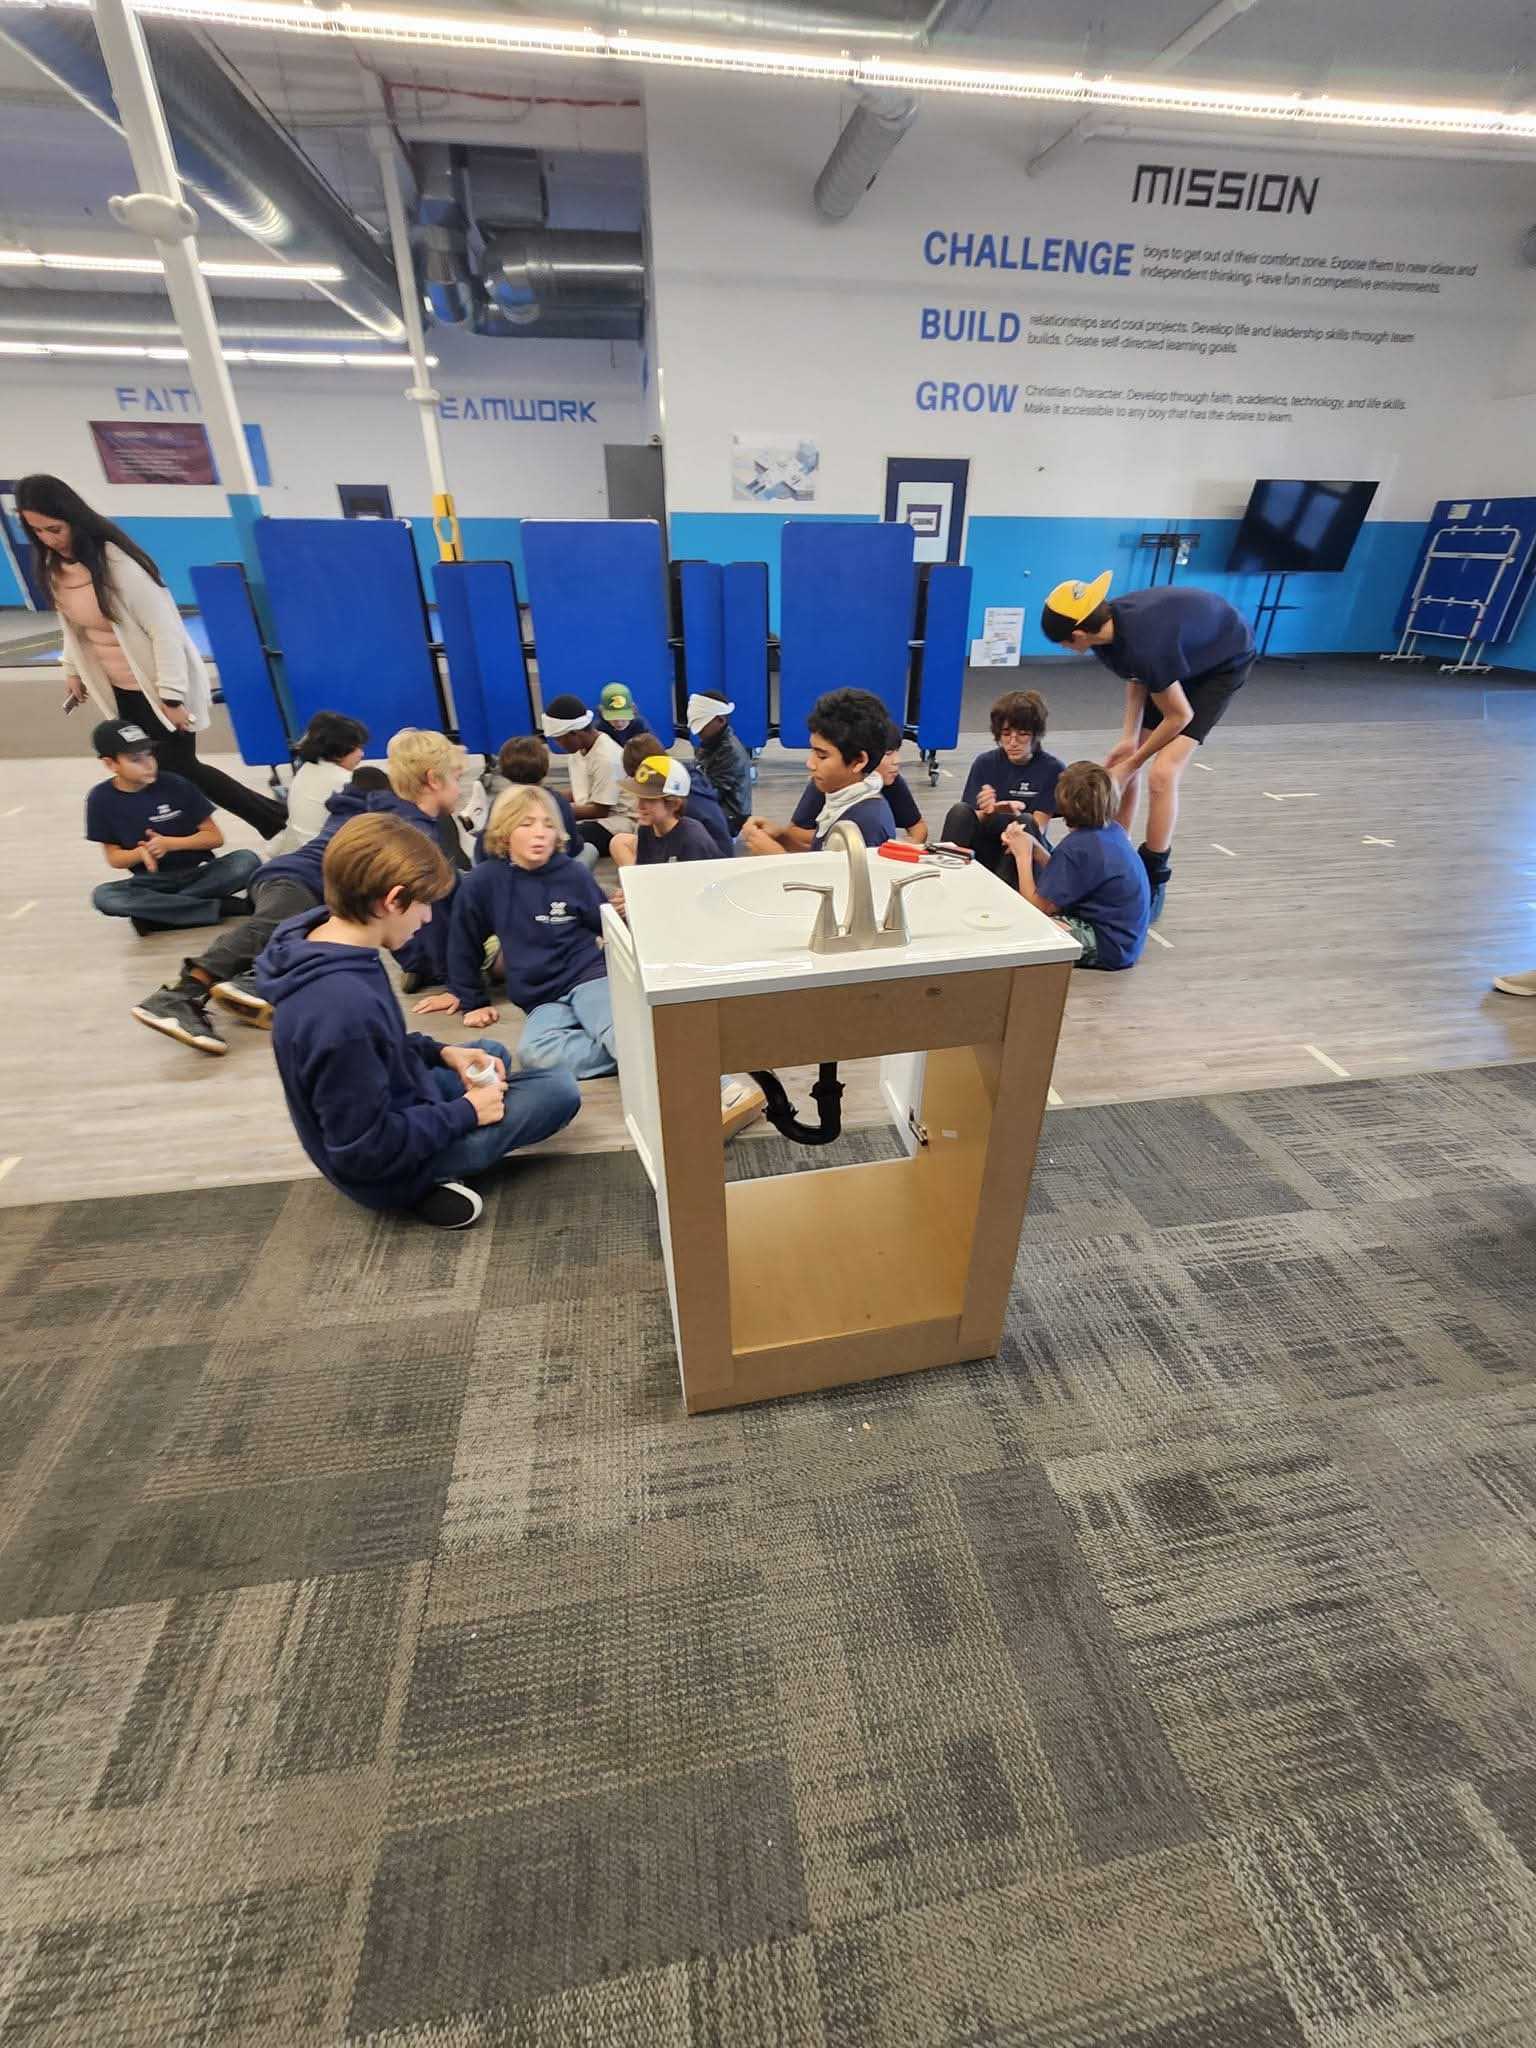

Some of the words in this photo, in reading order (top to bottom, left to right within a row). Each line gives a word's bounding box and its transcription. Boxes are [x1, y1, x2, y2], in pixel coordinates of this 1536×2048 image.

[1132, 164, 1320, 215] MISSION
[923, 230, 1135, 277] CHALLENGE
[1143, 245, 1169, 261] boys
[1171, 248, 1181, 259] to
[1184, 249, 1201, 263] get
[1203, 250, 1220, 262] out
[1222, 249, 1234, 262] of
[1235, 250, 1257, 264] their
[1260, 252, 1300, 266] comfort
[1331, 255, 1366, 270] Expose
[1457, 263, 1479, 277] and
[1256, 272, 1281, 286] Have
[1284, 272, 1300, 287] fun
[1301, 275, 1312, 288] in
[1313, 276, 1371, 291] competitive
[920, 308, 1021, 343] BUILD
[1029, 314, 1097, 330] relationships
[1099, 317, 1120, 330] and
[1121, 319, 1144, 331] cool
[1191, 321, 1233, 337] Develop
[1234, 323, 1250, 336] life
[1251, 324, 1272, 337] and
[1272, 325, 1323, 341] leadership
[1325, 327, 1349, 341] skills
[1351, 328, 1389, 345] through
[1064, 333, 1098, 347] Create
[1166, 339, 1206, 355] learning
[916, 381, 1019, 413] GROW
[1024, 402, 1051, 415] Make
[1053, 403, 1061, 415] it
[1062, 404, 1114, 417] accessible
[1116, 406, 1126, 417] to
[1128, 408, 1146, 421] any
[1149, 407, 1166, 421] boy
[1168, 408, 1188, 420] that
[1190, 408, 1206, 420] has
[1208, 410, 1224, 421] the
[1226, 410, 1254, 422] desire
[1256, 411, 1266, 422] to
[1025, 384, 1071, 398] Christian
[1127, 388, 1168, 404] Develop
[1170, 390, 1209, 405] through
[1348, 397, 1365, 409] and
[1366, 397, 1381, 409] life
